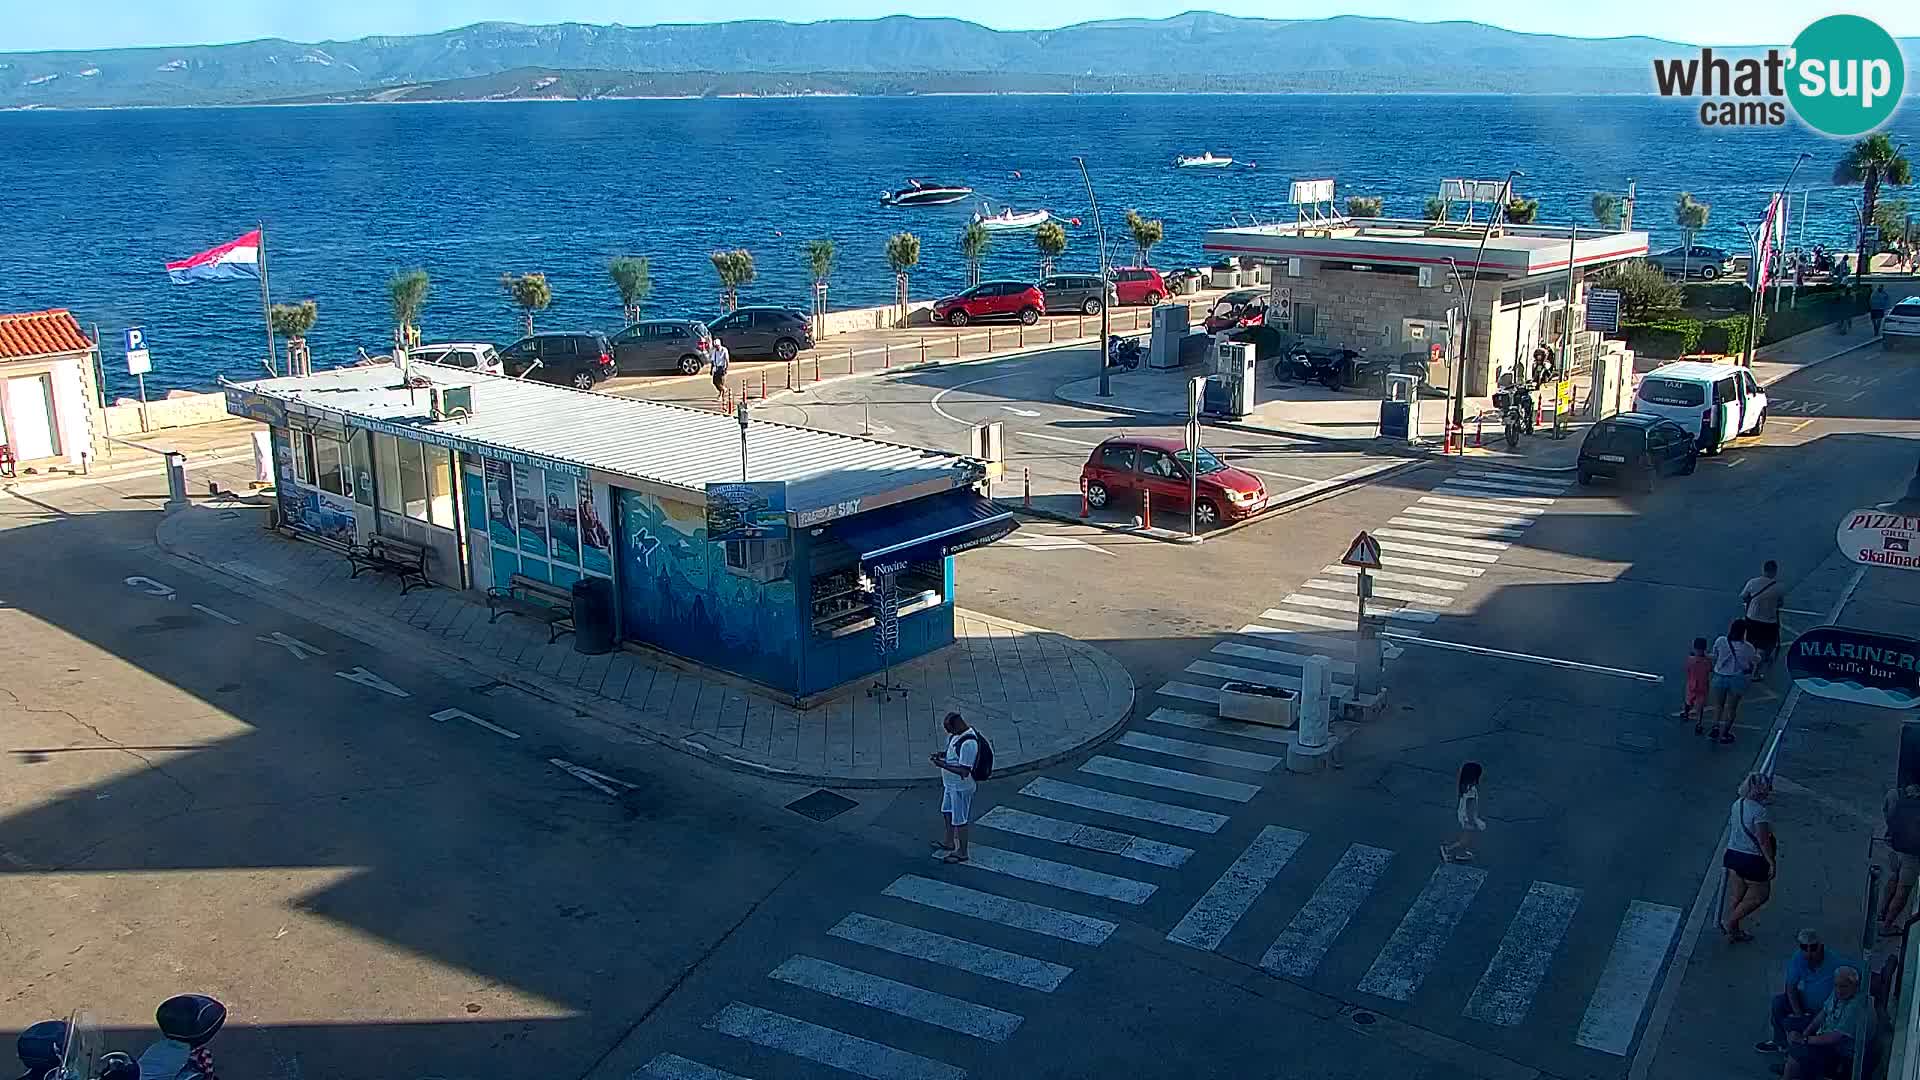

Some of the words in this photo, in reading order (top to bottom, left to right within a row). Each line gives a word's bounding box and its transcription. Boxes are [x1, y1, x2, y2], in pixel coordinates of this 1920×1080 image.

[130, 330, 143, 349] P
[1665, 381, 1683, 389] TAXI
[478, 445, 493, 457] BUS
[493, 449, 526, 464] STATION
[528, 456, 555, 470] TICKET
[555, 462, 582, 476] OFFICE
[1880, 529, 1916, 540] GRILL
[873, 560, 908, 577] Novine
[1828, 661, 1864, 674] caffe
[1870, 664, 1896, 679] bar
